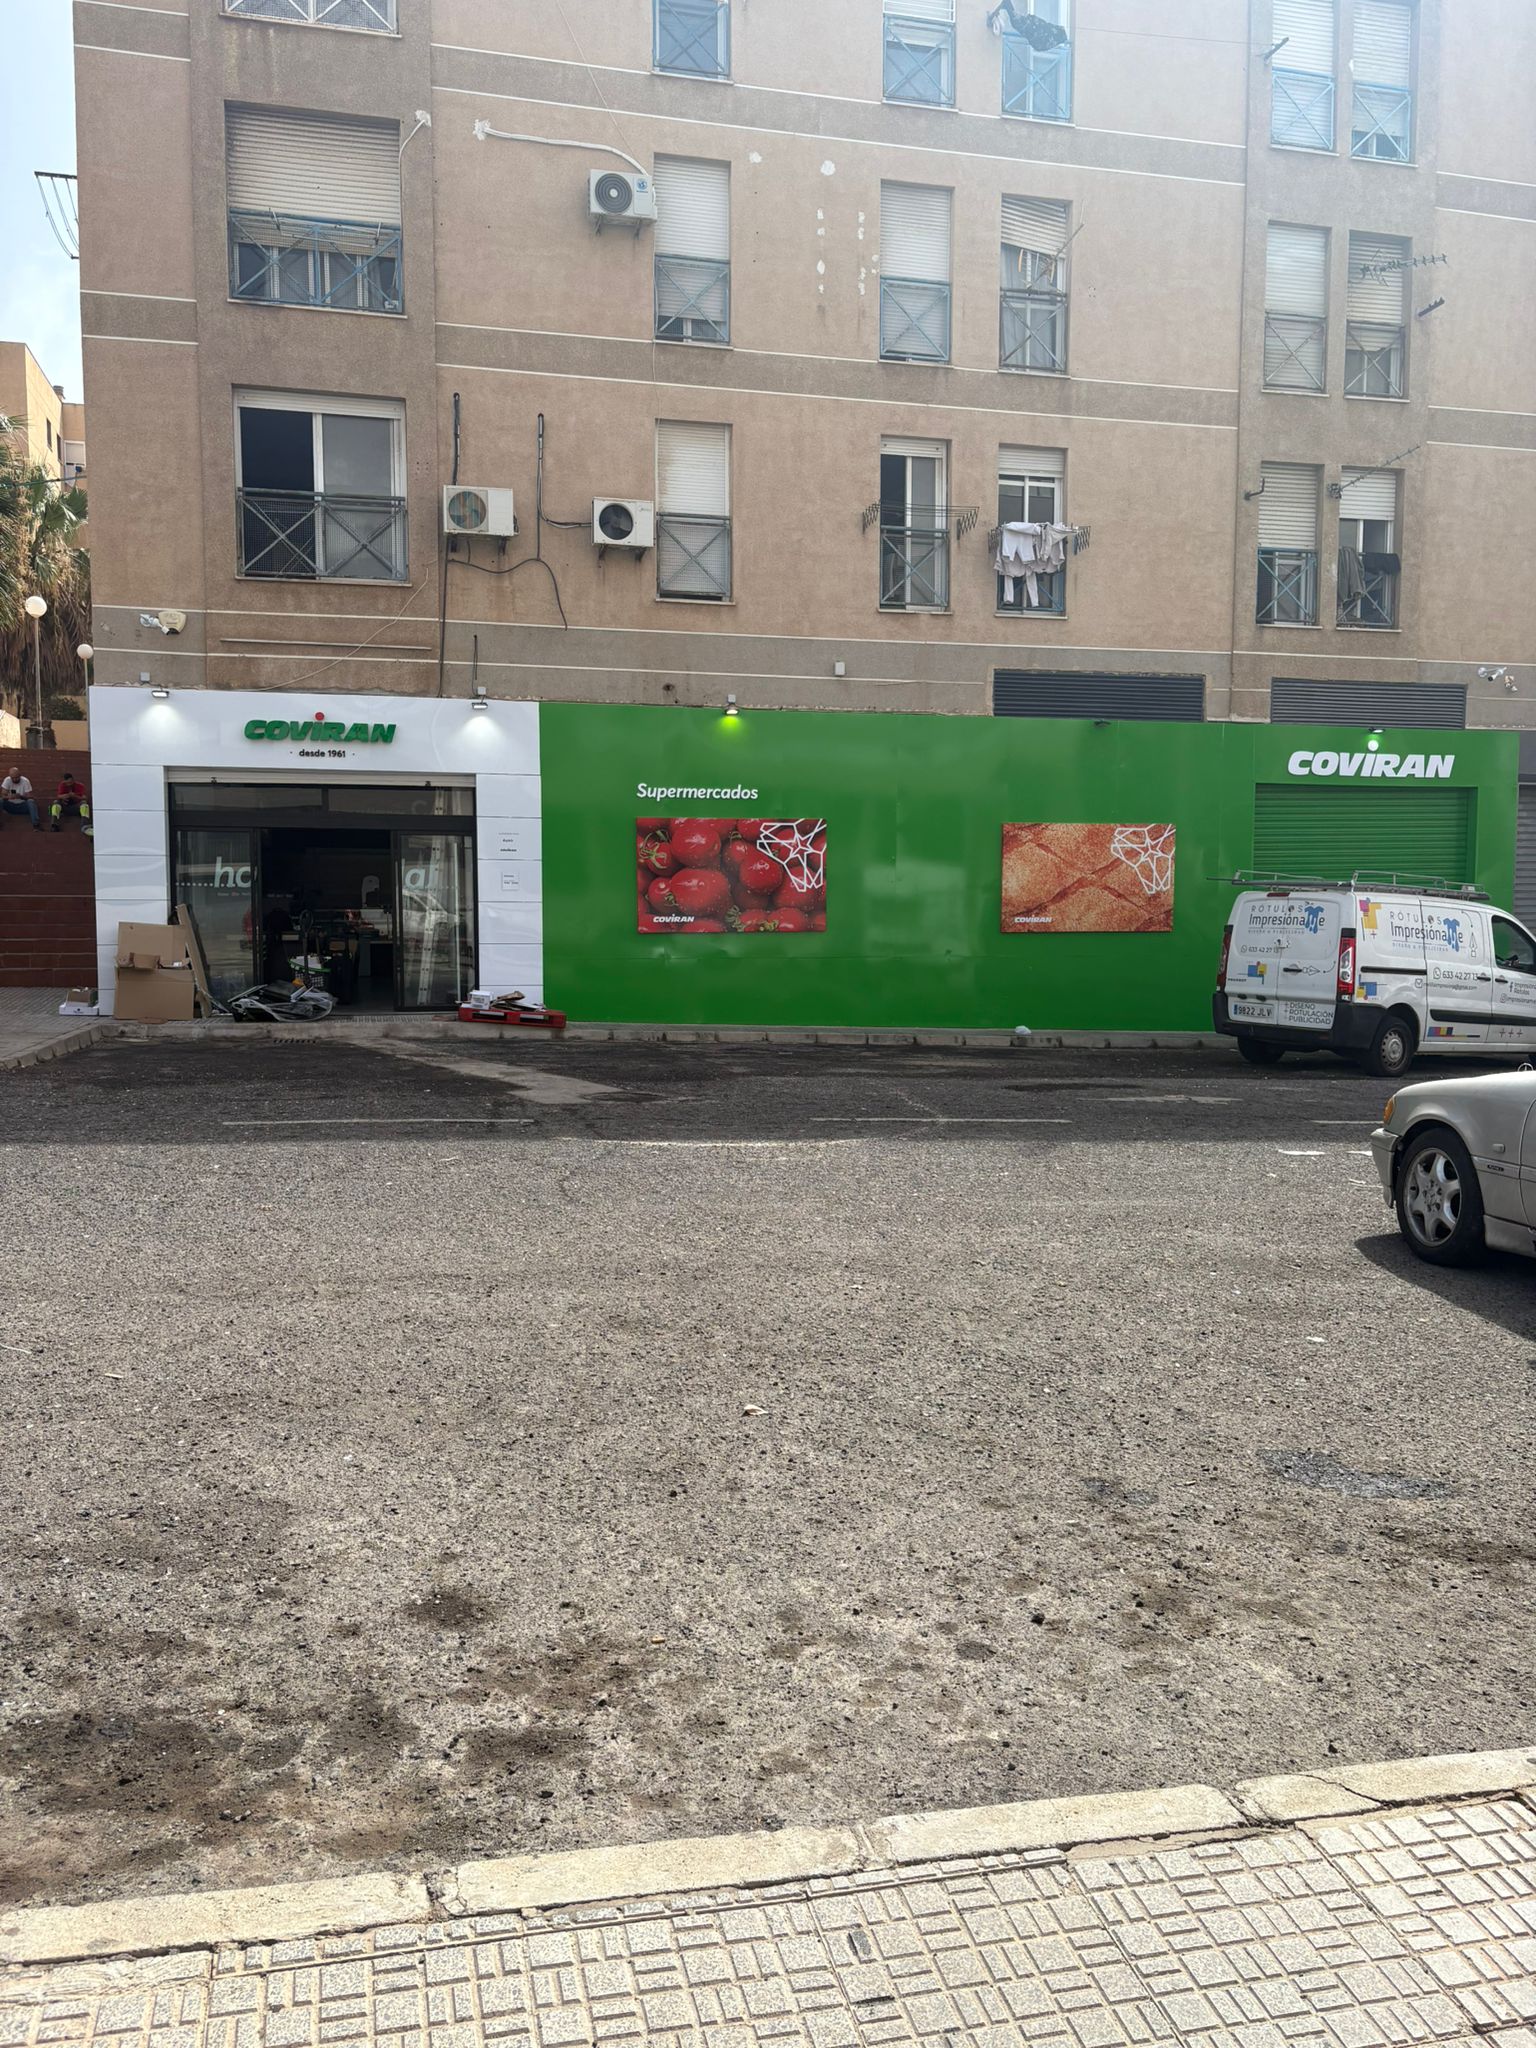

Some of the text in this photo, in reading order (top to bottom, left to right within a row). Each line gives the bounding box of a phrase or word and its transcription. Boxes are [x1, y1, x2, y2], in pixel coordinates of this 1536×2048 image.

[244, 712, 397, 744] COVIRAN
[298, 749, 346, 758] desde 1961
[1287, 740, 1455, 778] COVIRAN
[636, 782, 759, 801] Supermercados
[1442, 970, 1454, 979] 633
[1455, 971, 1463, 980] 42
[1463, 972, 1471, 980] 27
[1288, 1015, 1332, 1025] PUBLICIDAD
